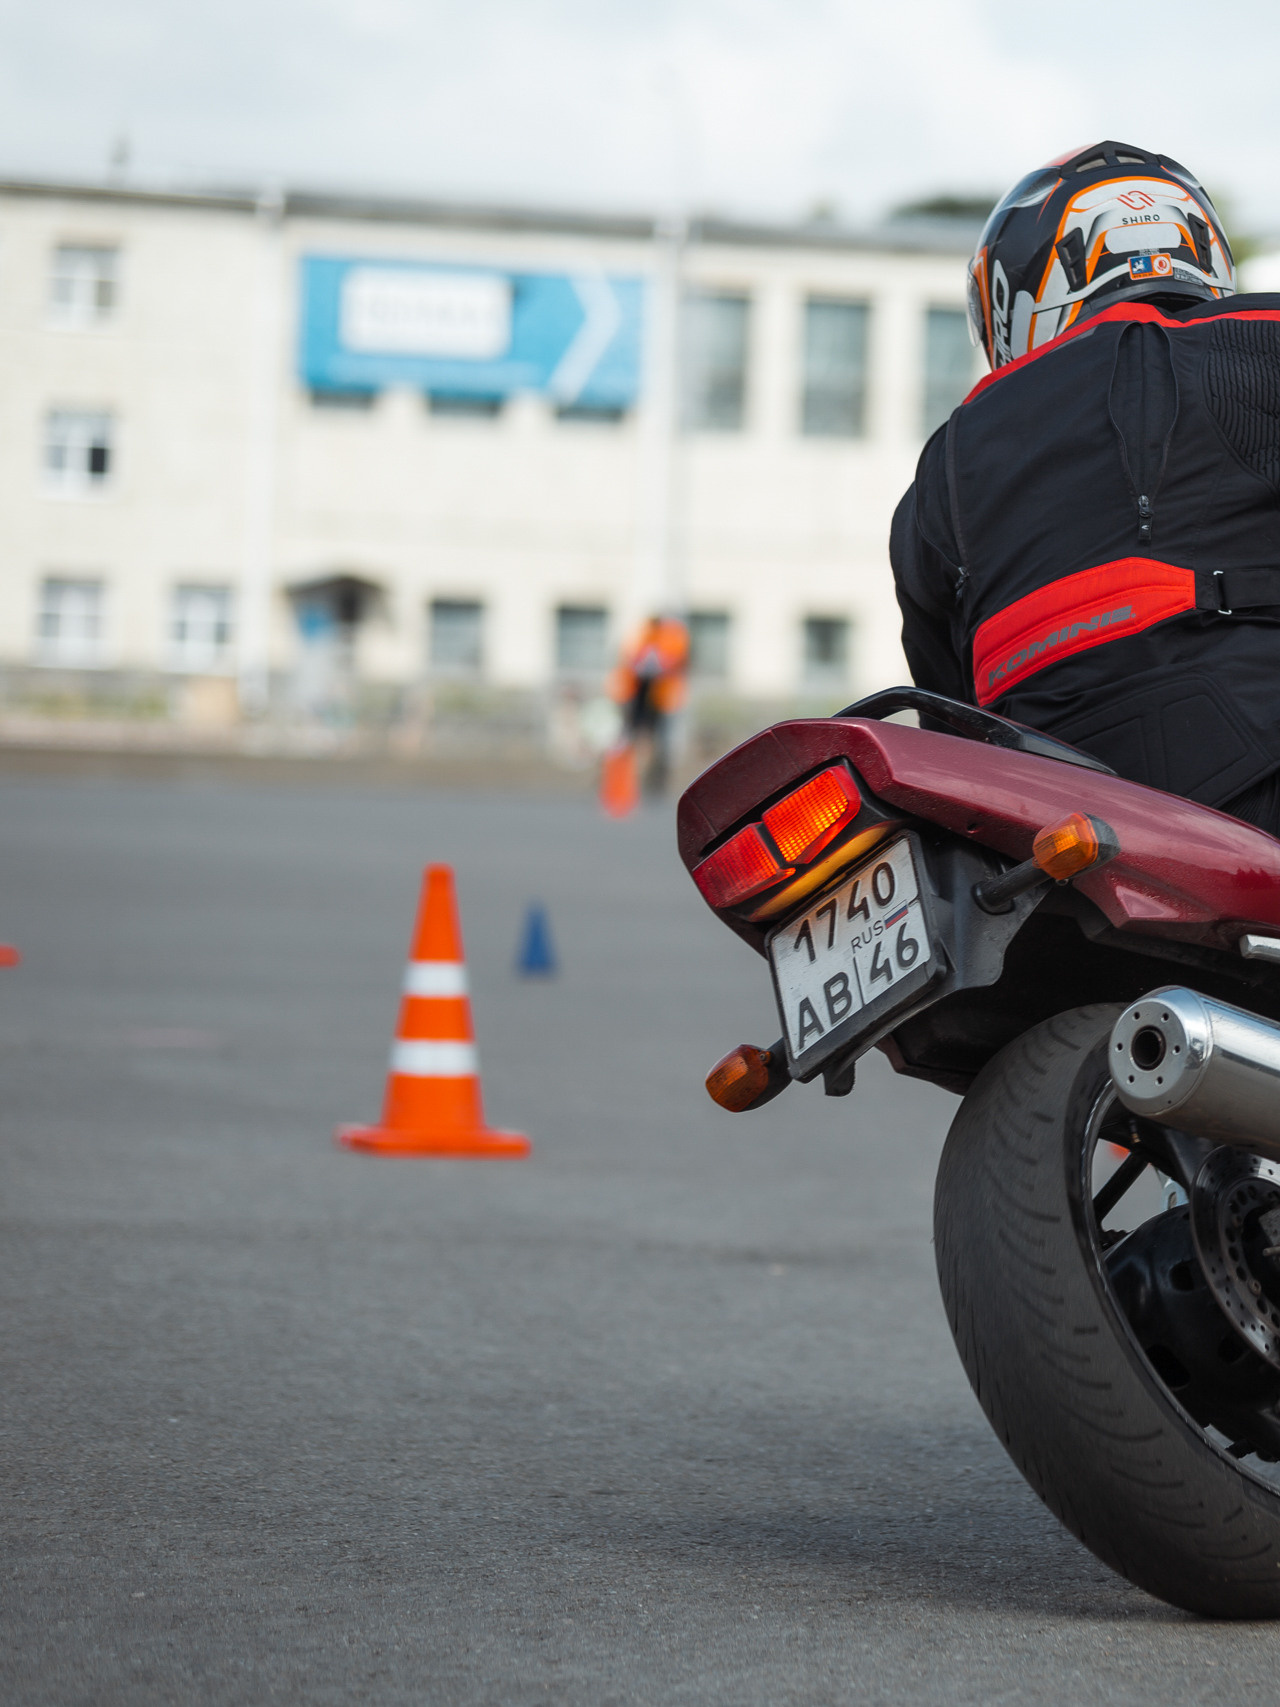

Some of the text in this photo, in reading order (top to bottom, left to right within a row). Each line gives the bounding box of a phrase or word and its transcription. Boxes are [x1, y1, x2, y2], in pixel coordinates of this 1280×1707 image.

[1121, 214, 1161, 225] SHIRO
[988, 605, 1133, 688] KOMINE
[793, 861, 896, 962] 1740
[850, 920, 884, 954] RUS
[869, 922, 920, 984] 46
